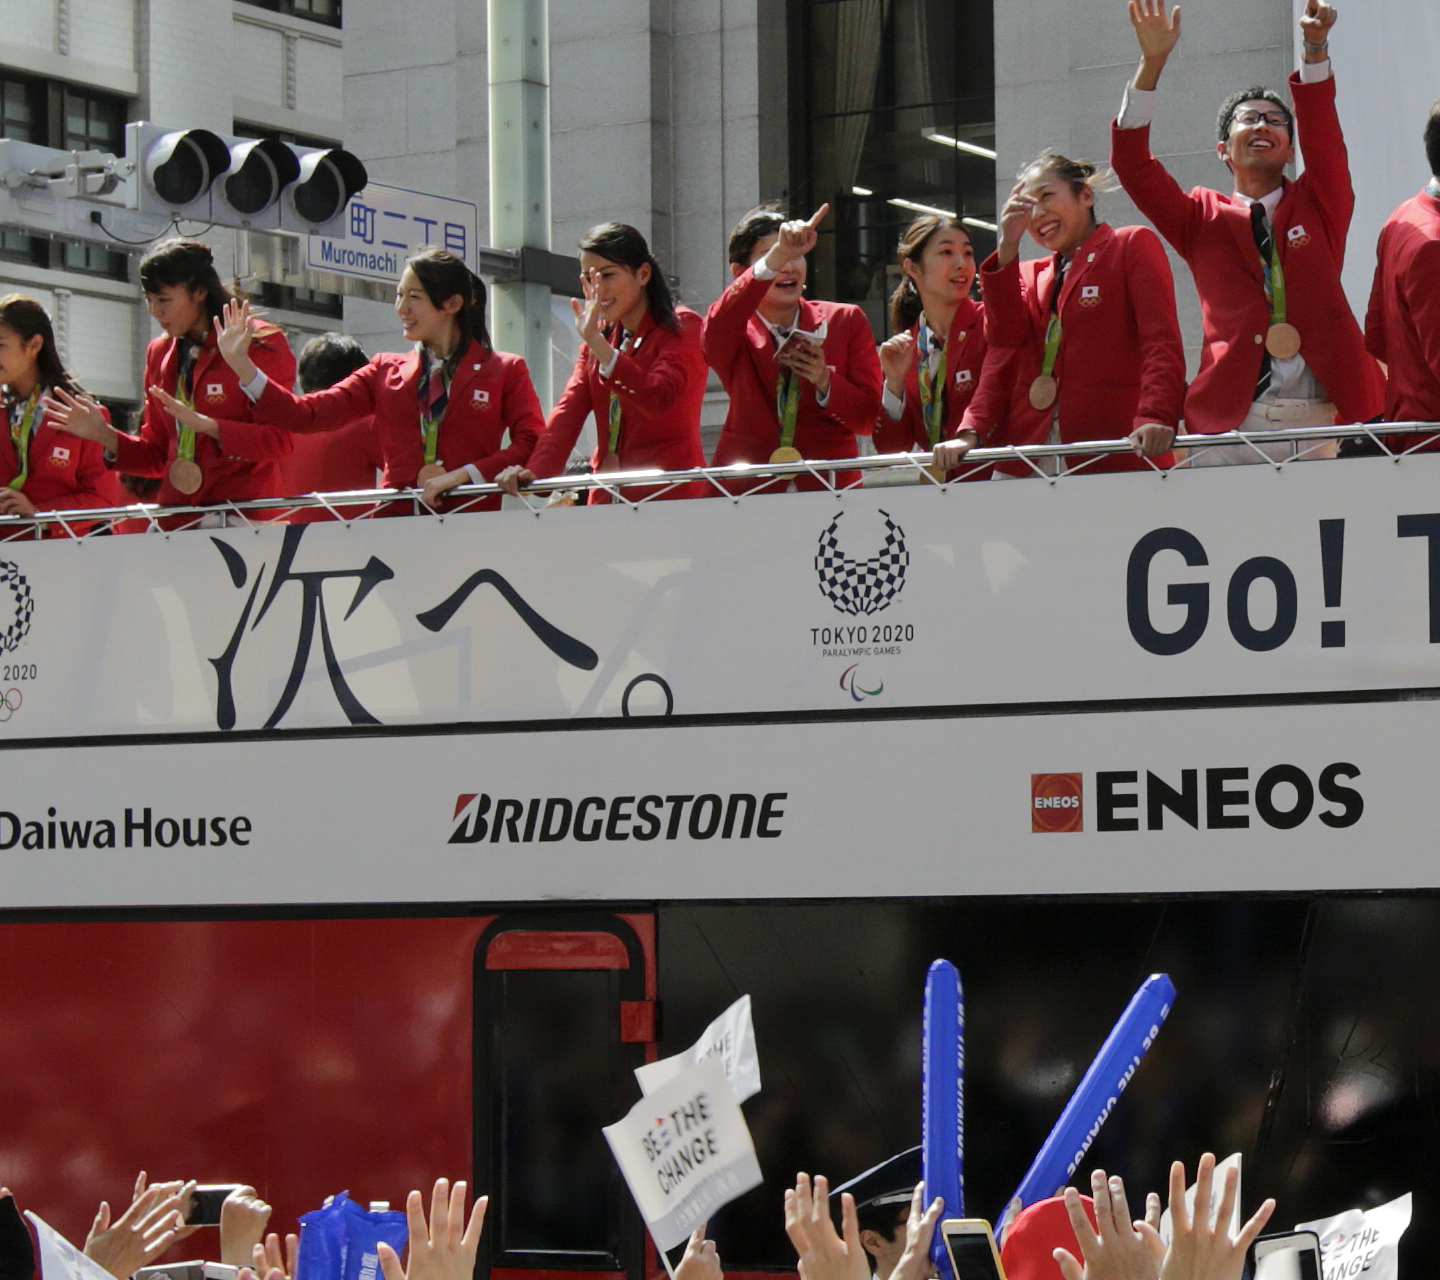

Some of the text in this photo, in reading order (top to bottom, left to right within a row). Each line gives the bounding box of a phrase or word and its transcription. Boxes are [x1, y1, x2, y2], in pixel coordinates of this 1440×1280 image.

[321, 239, 398, 275] Muromachi
[350, 200, 466, 262] 町二丁目
[1127, 518, 1346, 657] Go!
[207, 522, 675, 730] 次へ。
[811, 623, 915, 646] TOKYO 2020
[822, 646, 902, 657] PARALYMPIC GAMES
[2, 663, 38, 681] 2020
[447, 792, 788, 844] BRIDGESTONE
[1034, 761, 1365, 832] ENEOS ENEOS
[642, 1091, 711, 1163] BE THE
[657, 1130, 718, 1195] CHANGE
[1349, 1226, 1382, 1257] THE
